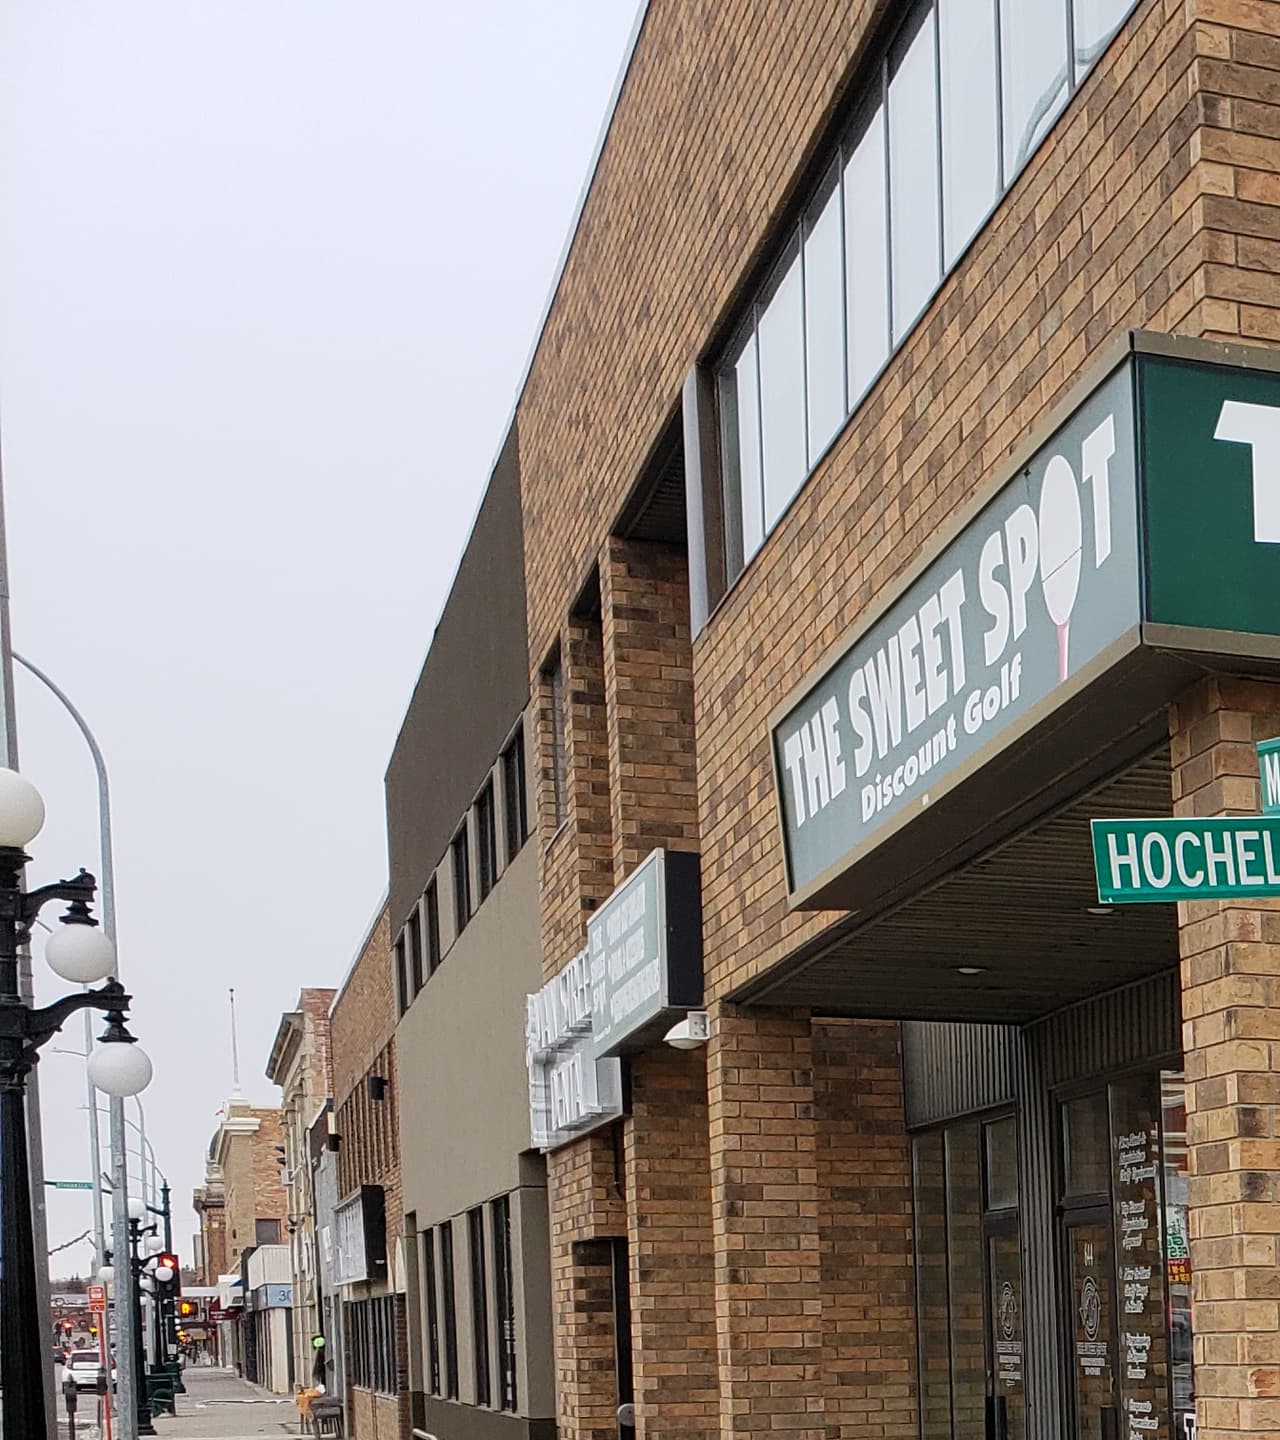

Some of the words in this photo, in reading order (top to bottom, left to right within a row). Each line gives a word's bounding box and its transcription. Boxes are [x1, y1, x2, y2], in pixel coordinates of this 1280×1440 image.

[784, 696, 847, 828] THE
[848, 568, 966, 778] SWEET
[979, 414, 1115, 667] SPOT
[862, 713, 957, 824] Discount
[963, 652, 1023, 736] Golf
